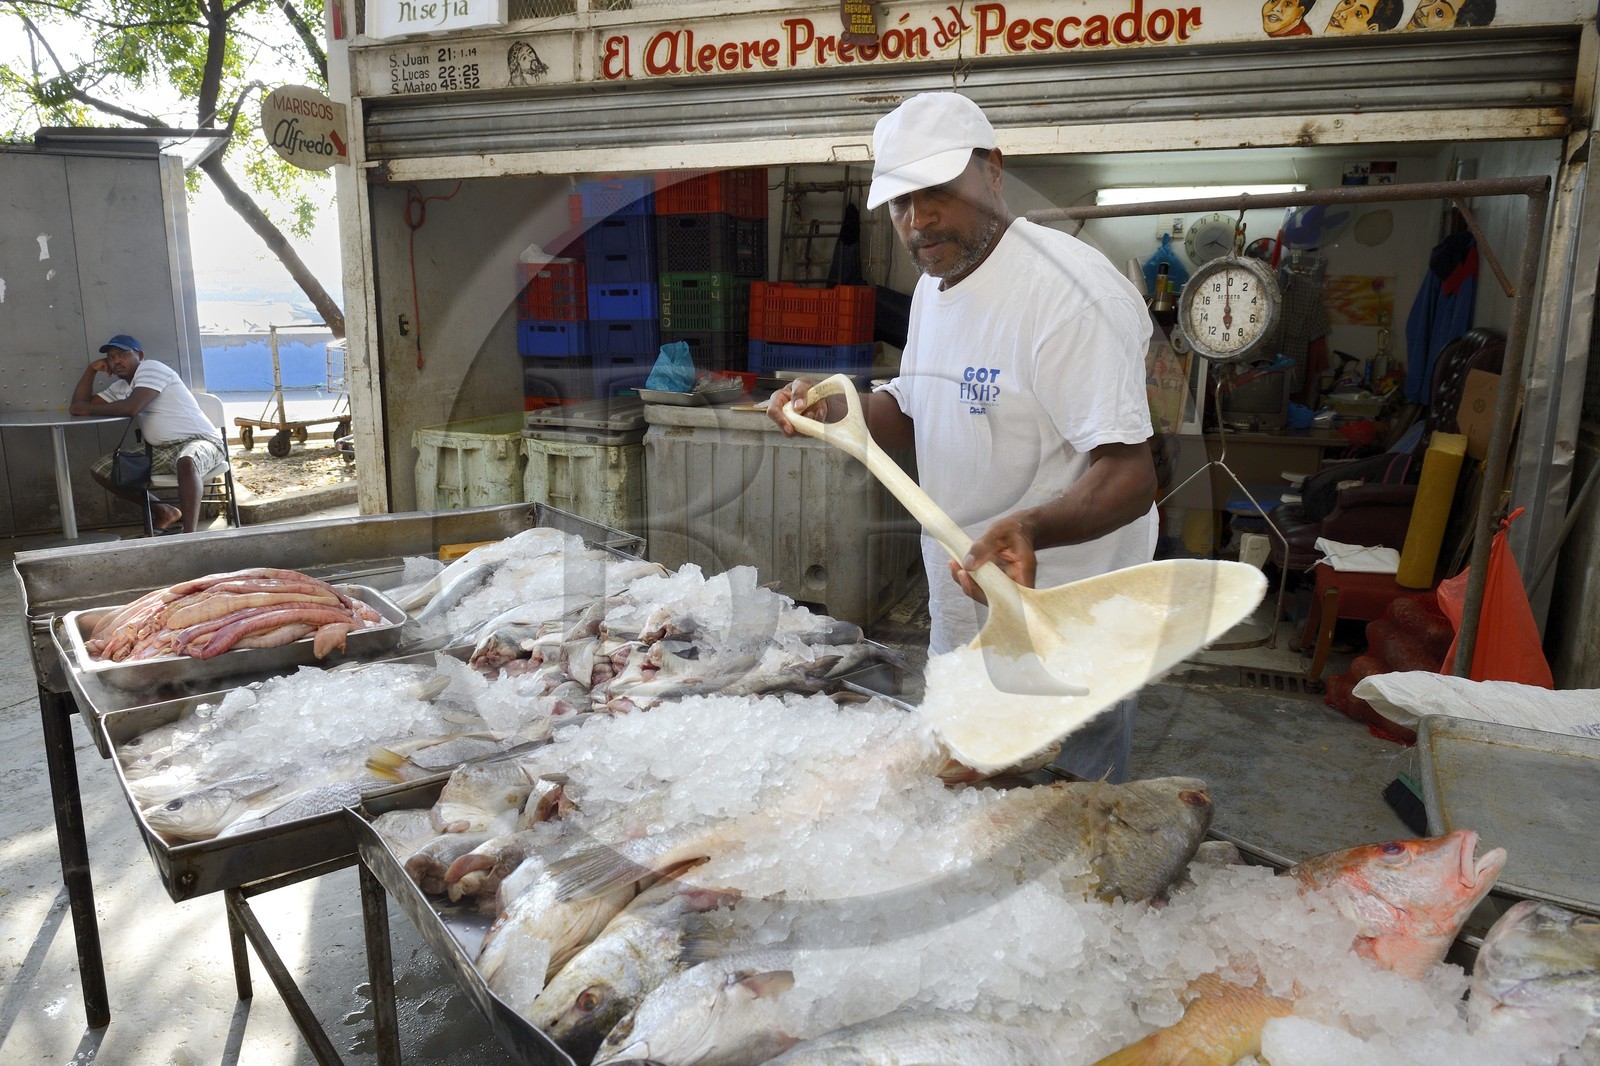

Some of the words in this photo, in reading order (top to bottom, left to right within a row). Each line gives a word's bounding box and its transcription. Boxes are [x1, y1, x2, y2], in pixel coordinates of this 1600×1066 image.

[851, 14, 873, 24] ESTE
[602, 36, 633, 80] El
[645, 29, 781, 76] Alegre
[932, 5, 972, 49] del
[973, 0, 1203, 55] Pescador
[402, 53, 430, 67] Juan
[402, 68, 430, 81] Lucas
[438, 63, 479, 79] 22:25
[402, 81, 438, 94] Mateo
[440, 76, 480, 91] 45:52
[273, 93, 334, 121] MARISCOS
[269, 118, 334, 156] Alfredo
[1228, 277, 1234, 287] 0
[1212, 283, 1221, 292] 18
[1242, 283, 1249, 292] 2
[1202, 296, 1211, 305] 16
[1251, 296, 1258, 306] 4
[1200, 312, 1209, 322] 14
[1249, 313, 1256, 323] 6
[1208, 326, 1217, 336] 12
[1238, 327, 1244, 337] 8
[1221, 332, 1230, 342] 10
[963, 366, 1001, 383] GOT
[960, 382, 1001, 402] FISH?
